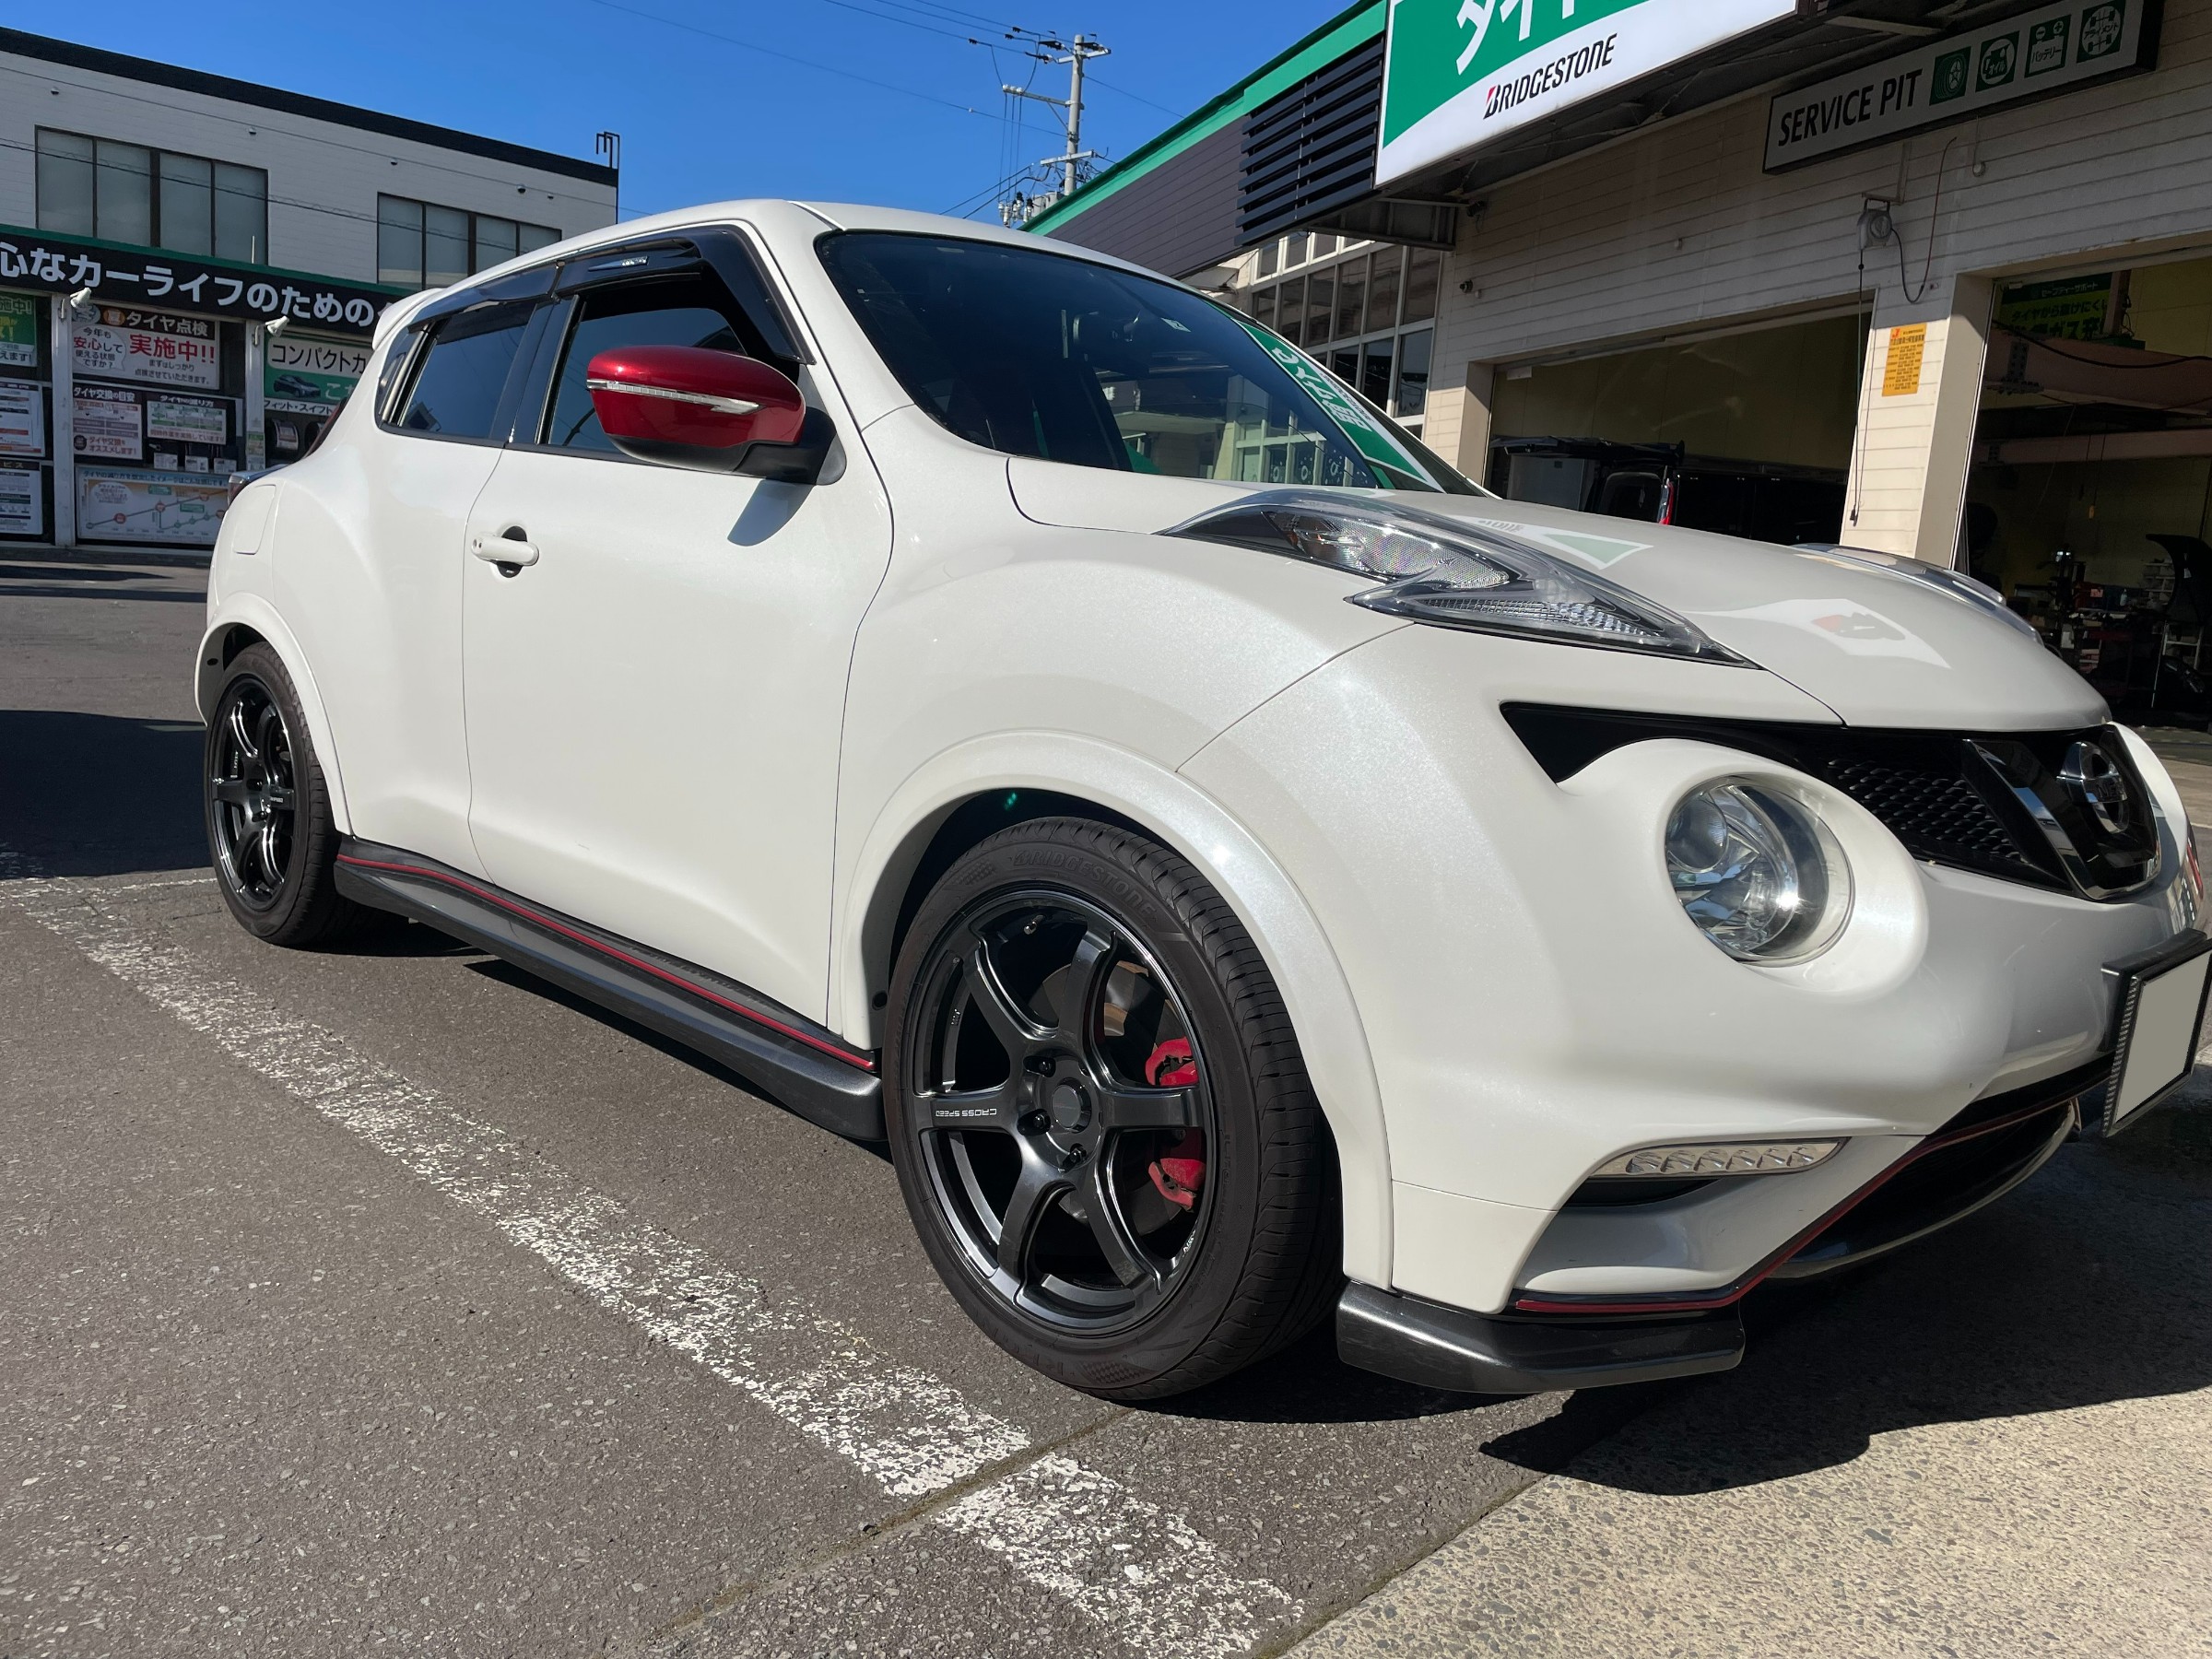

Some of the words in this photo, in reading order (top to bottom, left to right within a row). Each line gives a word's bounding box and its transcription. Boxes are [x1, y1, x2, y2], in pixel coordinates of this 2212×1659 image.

[2030, 48, 2063, 64] バッテリー
[1483, 32, 1618, 120] BRIDGESTONE
[1988, 60, 2006, 75] オイル
[1778, 84, 1875, 147] SERVICE
[1879, 68, 1924, 116] PIT
[0, 241, 393, 328] 心なカーライフのための
[83, 326, 112, 339] 今年も
[126, 311, 208, 337] タイヤ点検
[73, 336, 123, 354] 安心して
[129, 334, 215, 364] 実施中!!
[1014, 849, 1159, 923] BRIDGESTONE
[935, 1109, 960, 1117] SPEED
[961, 1108, 997, 1117] CROSS
